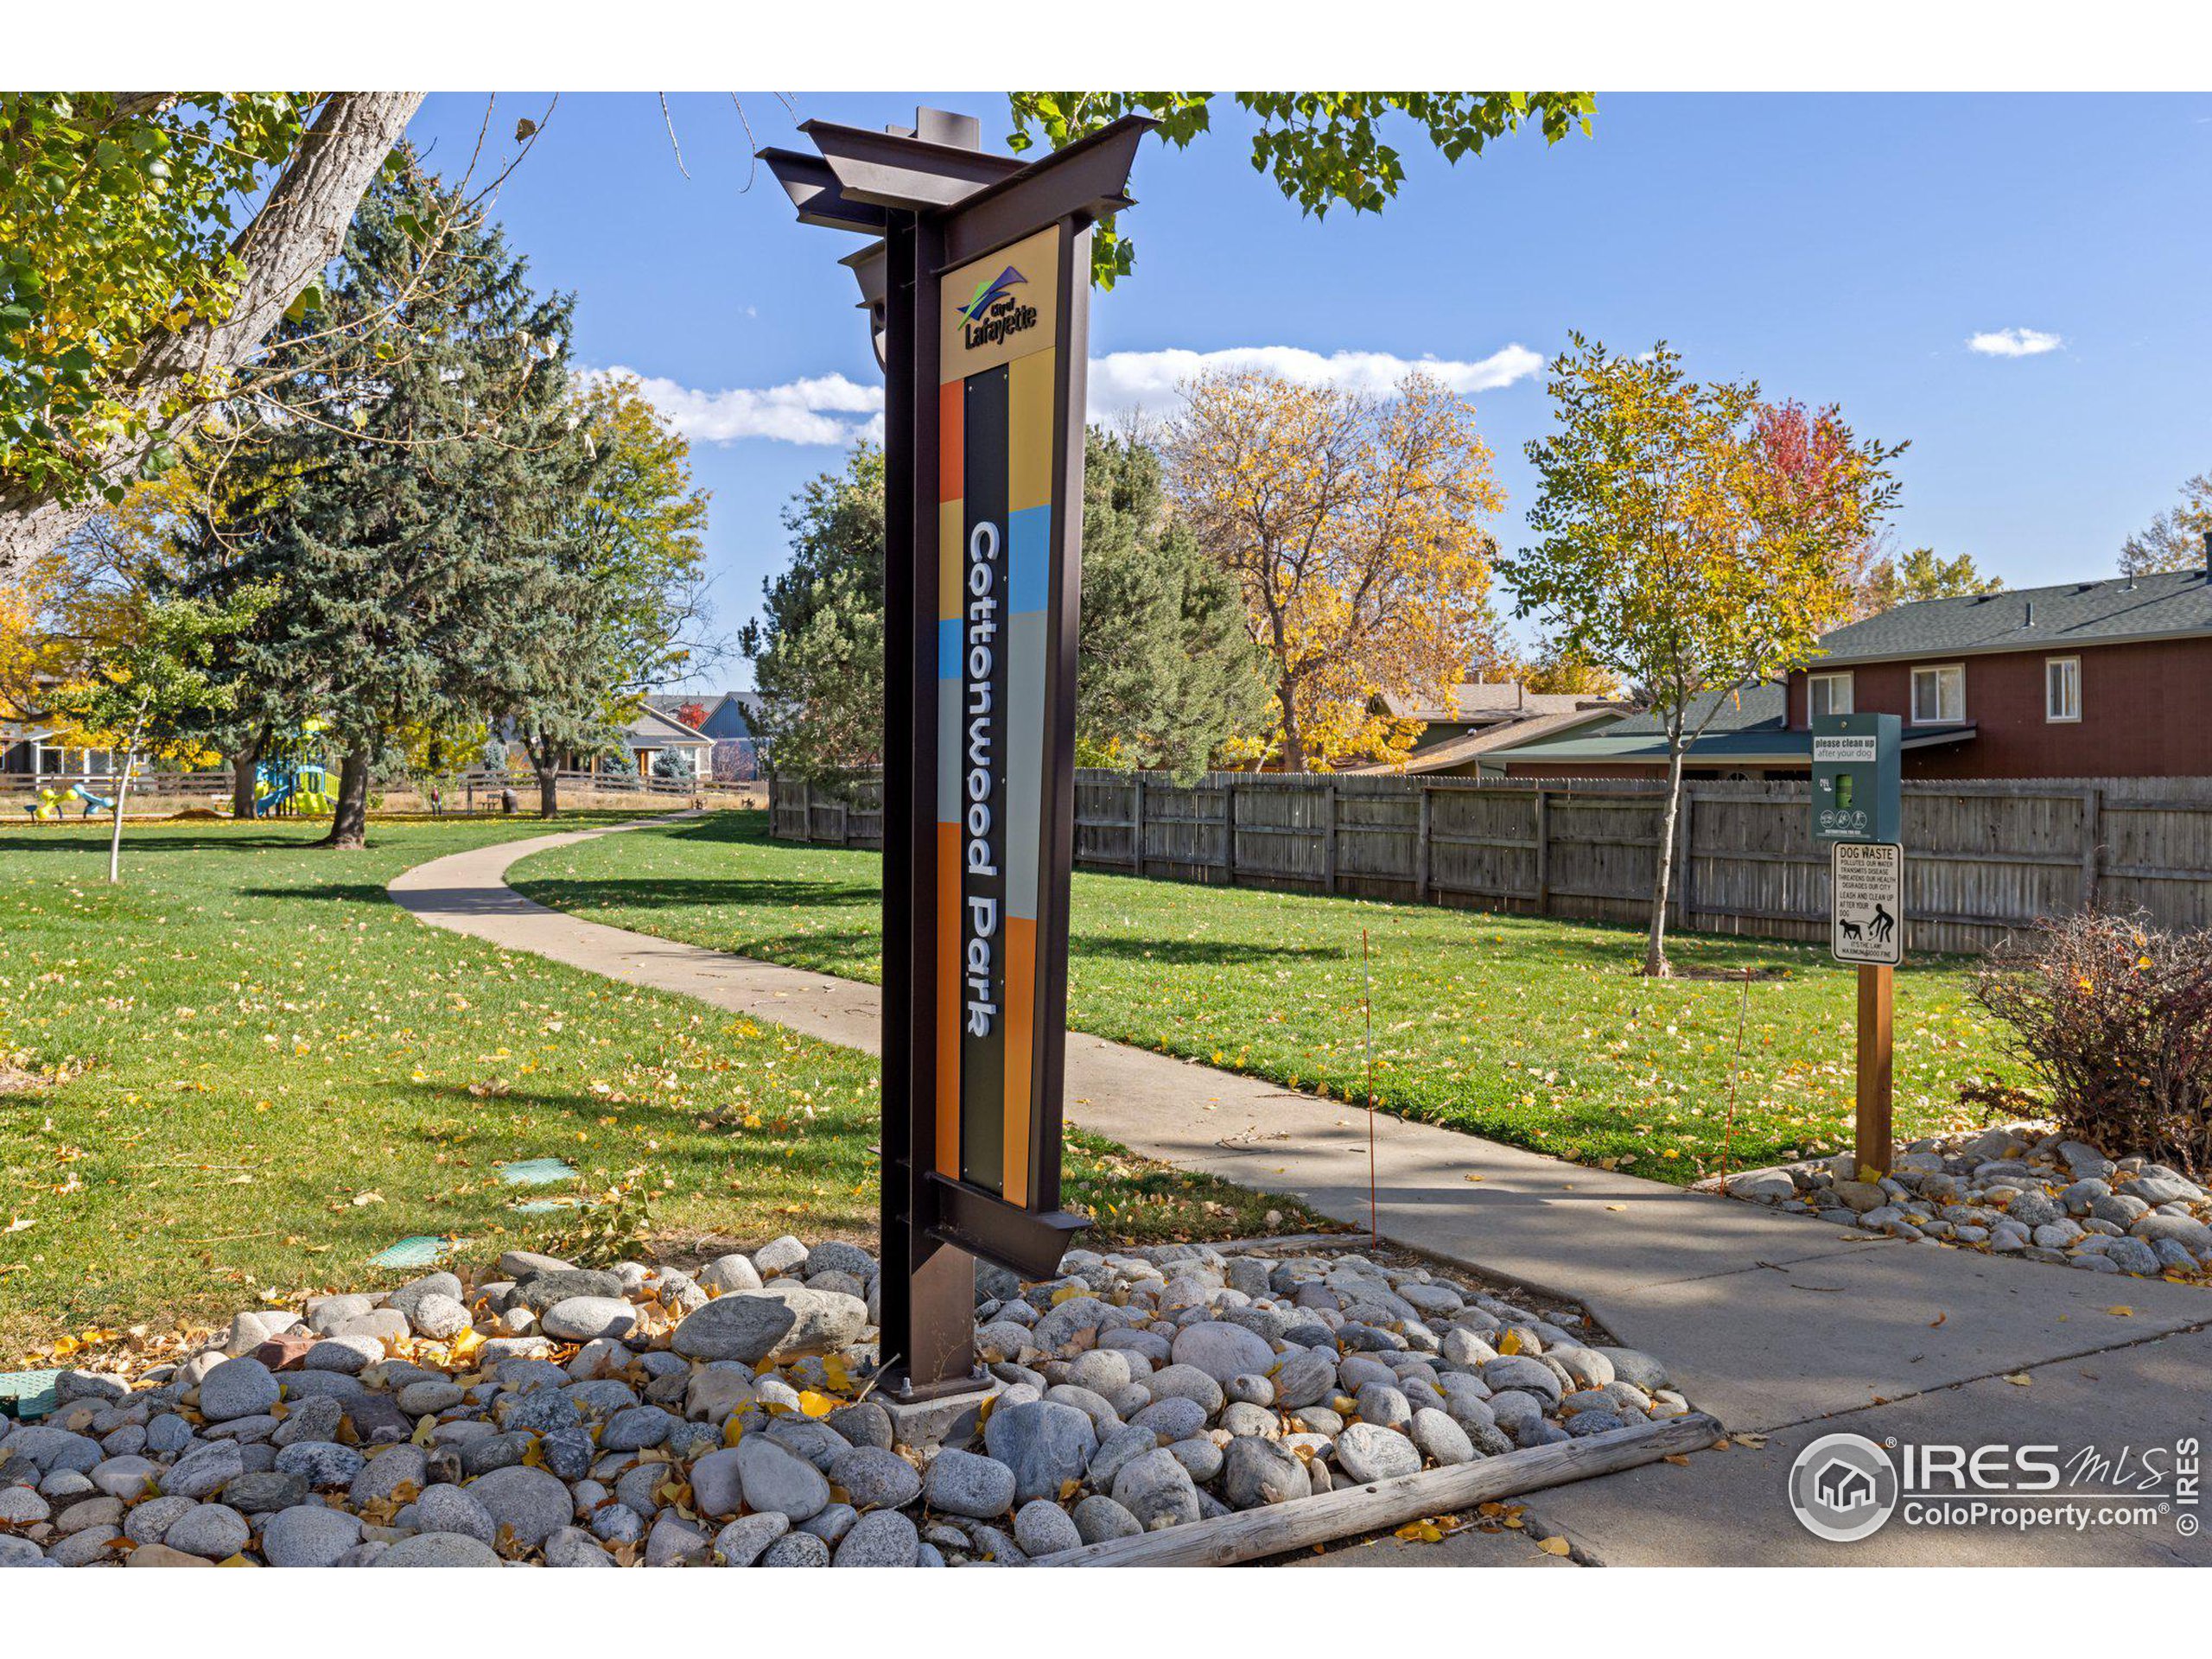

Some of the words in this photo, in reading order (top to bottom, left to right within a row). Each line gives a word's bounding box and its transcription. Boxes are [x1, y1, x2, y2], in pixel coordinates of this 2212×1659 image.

[965, 305, 1037, 350] Lafayette
[968, 521, 1000, 875] Cottonwood
[1815, 739, 1840, 748] please
[1841, 738, 1863, 747] clean
[1865, 740, 1875, 748] up
[1817, 749, 1836, 758] after
[1836, 750, 1854, 759] your
[1856, 748, 1872, 759] dog
[1840, 847, 1859, 858] DOG
[1861, 847, 1893, 860] WASTE
[967, 896, 997, 1038] Park
